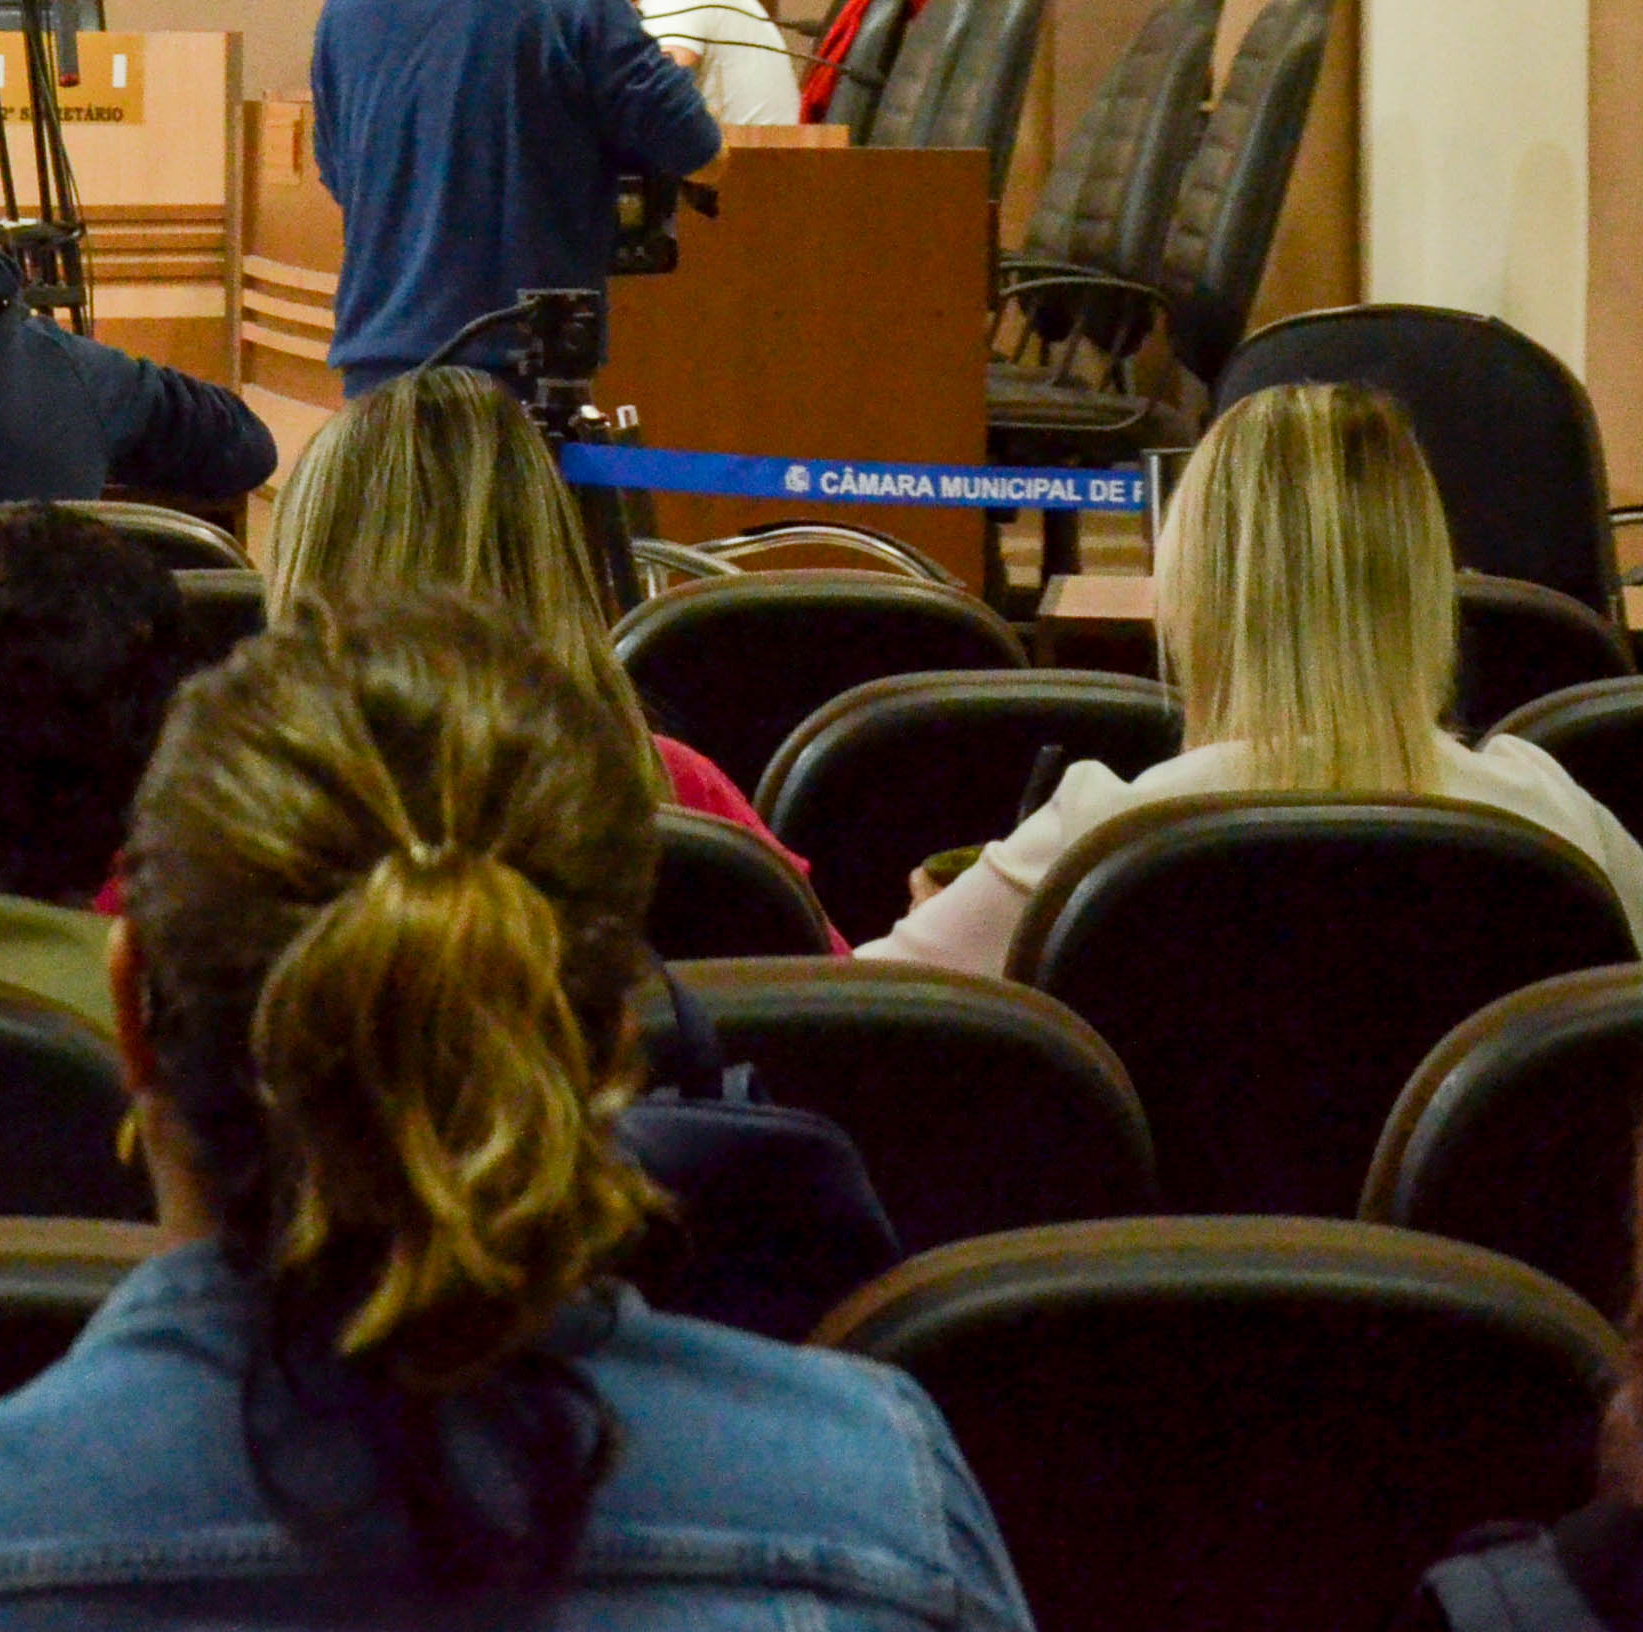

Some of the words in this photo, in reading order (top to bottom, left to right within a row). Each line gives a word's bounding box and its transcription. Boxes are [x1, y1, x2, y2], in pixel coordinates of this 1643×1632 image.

[819, 467, 935, 498] CÂMARA
[940, 475, 1082, 502] MUNICIPAL
[1089, 479, 1126, 503] DE
